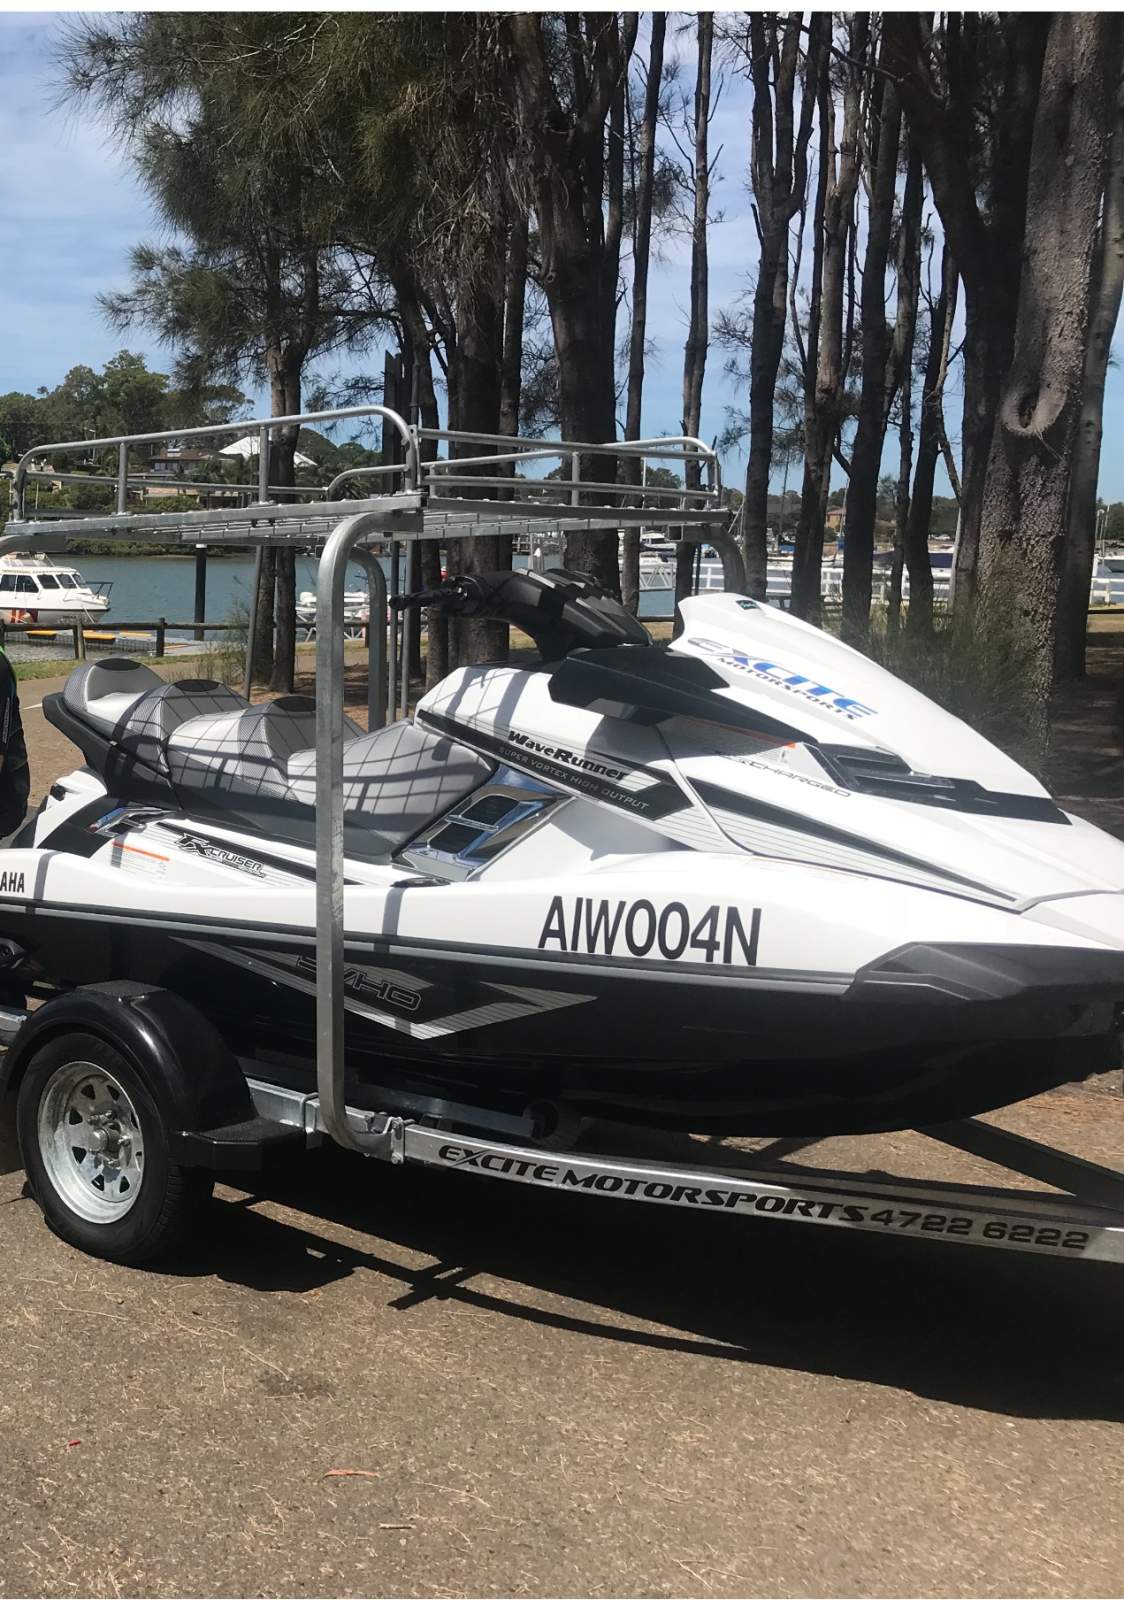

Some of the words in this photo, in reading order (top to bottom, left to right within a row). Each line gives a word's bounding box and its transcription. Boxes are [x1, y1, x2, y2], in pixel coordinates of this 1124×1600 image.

[687, 637, 878, 718] EXCITE
[716, 656, 856, 720] MOTORSPORTS
[500, 748, 529, 764] SUPER
[531, 759, 569, 779] VORTEX
[570, 775, 599, 791] HIGH
[601, 788, 650, 810] OUTPUT
[508, 730, 632, 781] WaveRunner
[210, 848, 266, 871] CRUISER
[438, 1144, 559, 1182] EXCITE
[561, 1169, 869, 1222] MOTORSPORTS
[869, 1209, 973, 1236] 4722
[981, 1221, 1090, 1251] 6222
